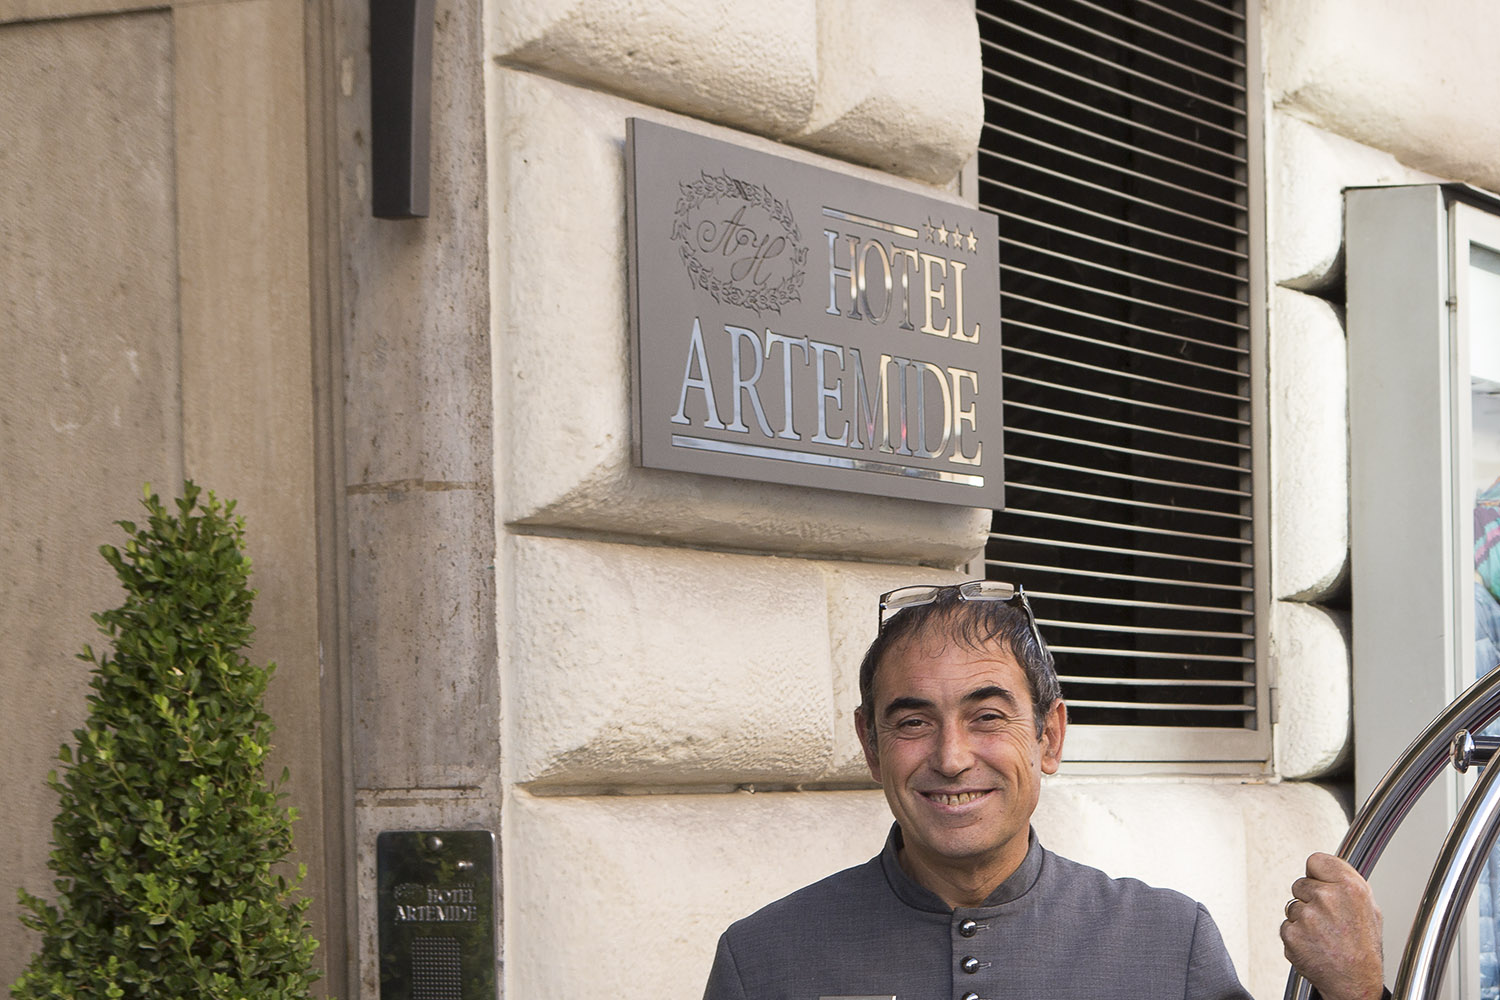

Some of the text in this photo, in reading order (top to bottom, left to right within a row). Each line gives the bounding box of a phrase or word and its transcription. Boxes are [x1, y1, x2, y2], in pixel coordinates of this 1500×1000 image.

[823, 228, 981, 344] HOTEL
[670, 316, 984, 466] ARTEMIDE
[395, 905, 477, 921] ARTEMIDE
[427, 888, 476, 904] HOTEL
